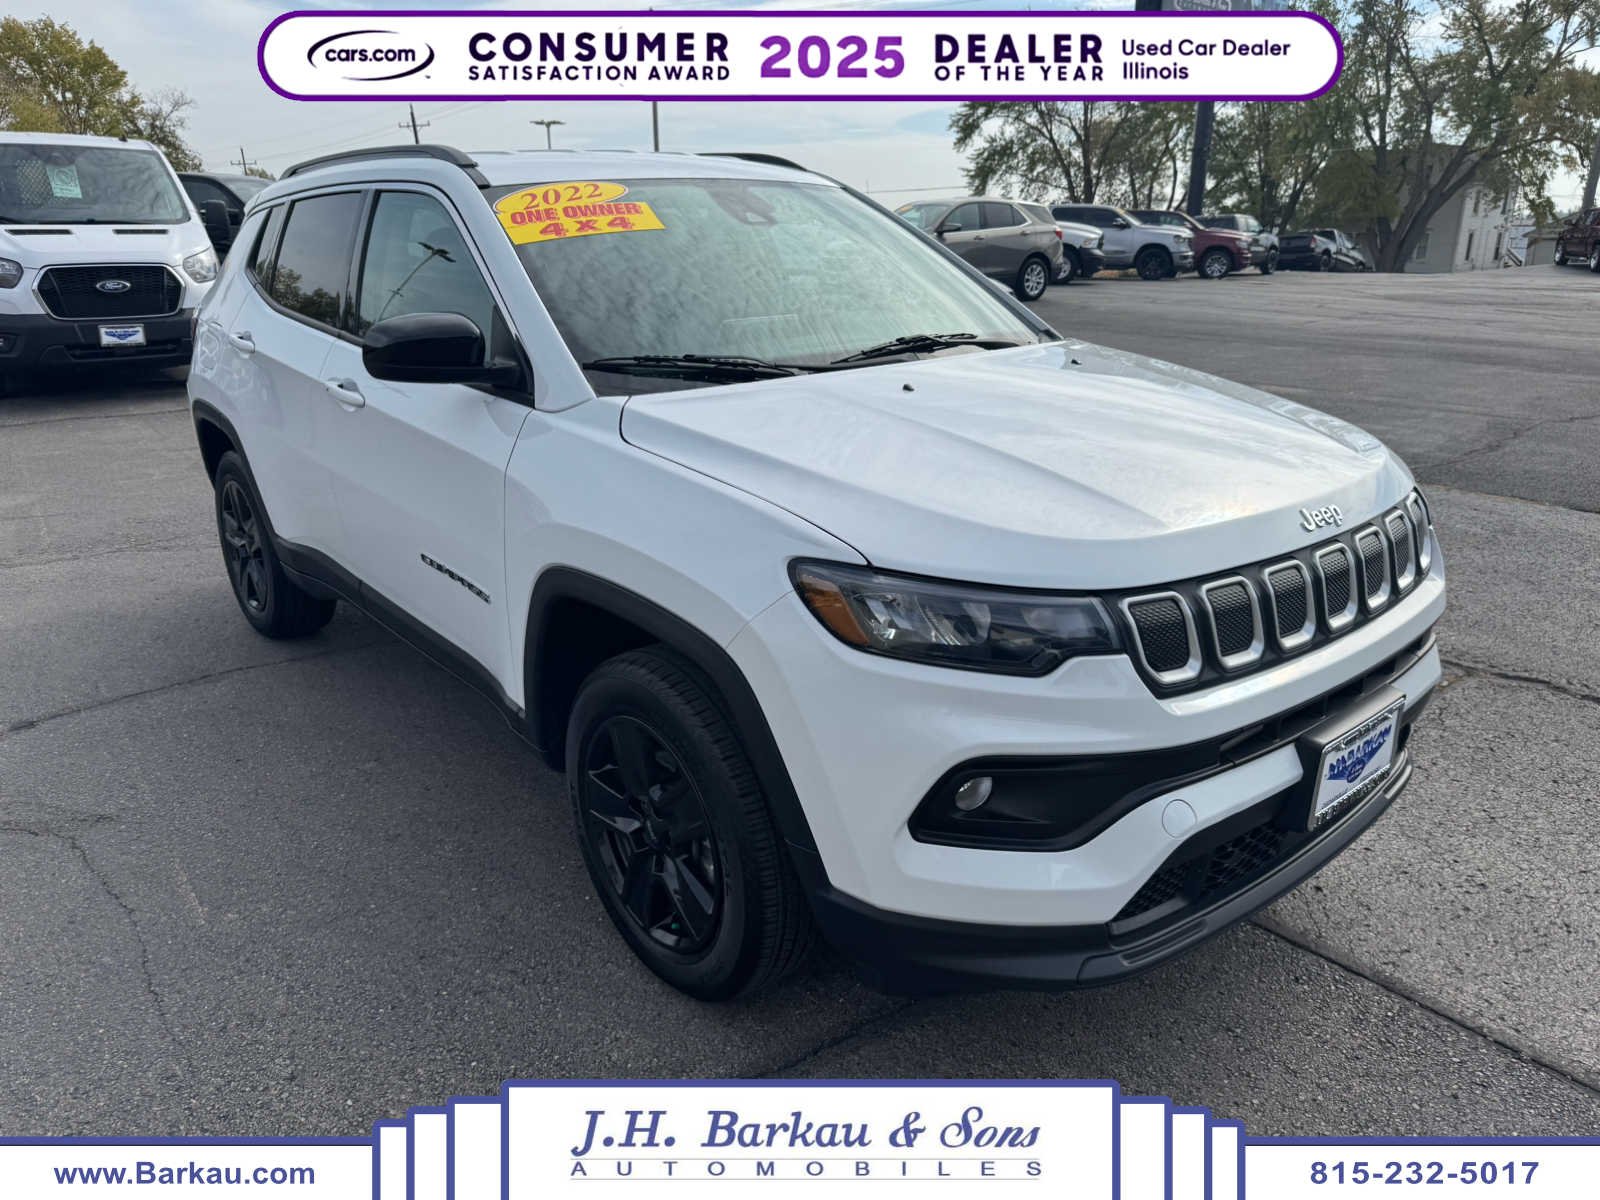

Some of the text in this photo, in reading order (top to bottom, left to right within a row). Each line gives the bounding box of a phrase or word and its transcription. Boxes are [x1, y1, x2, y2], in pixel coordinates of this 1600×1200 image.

[520, 183, 603, 211] 2022
[510, 202, 642, 225] ONE OWNER
[1299, 504, 1343, 532] Jeep
